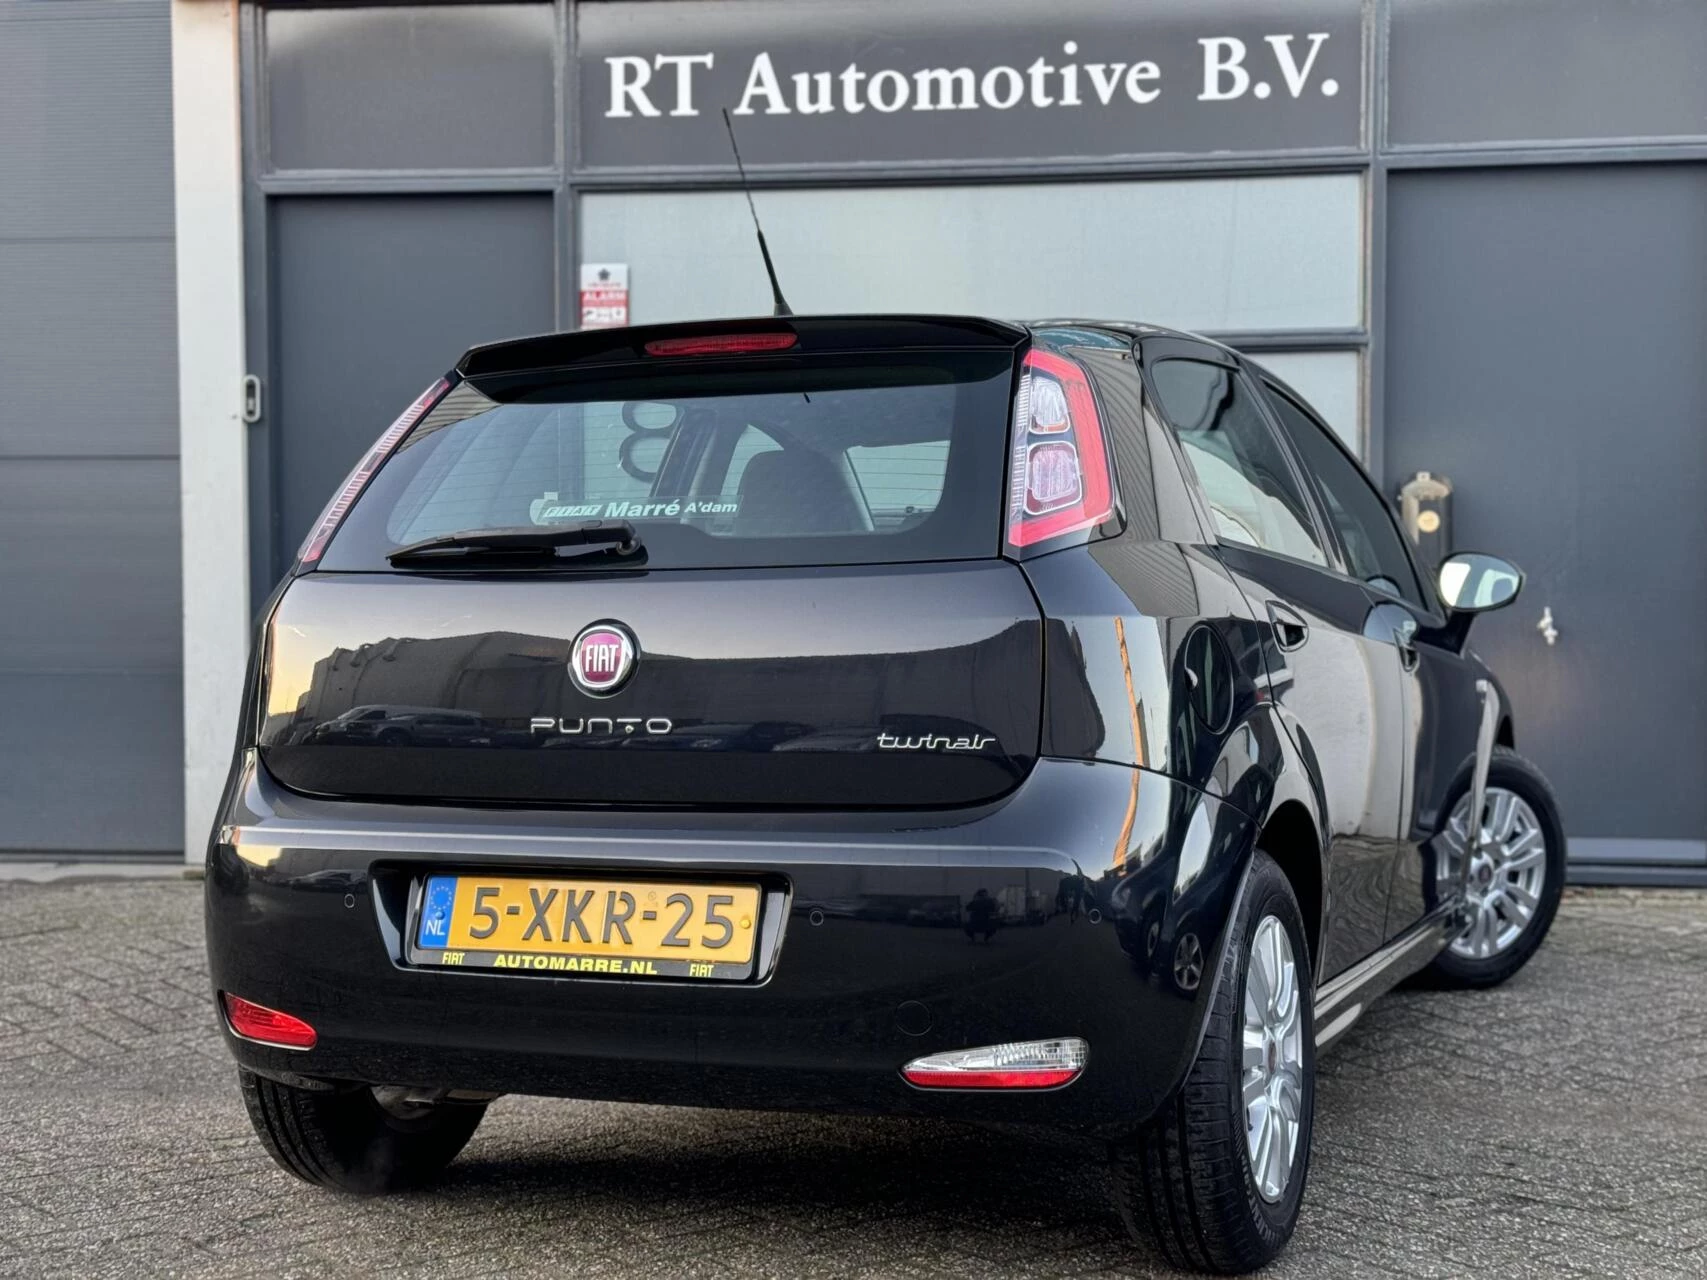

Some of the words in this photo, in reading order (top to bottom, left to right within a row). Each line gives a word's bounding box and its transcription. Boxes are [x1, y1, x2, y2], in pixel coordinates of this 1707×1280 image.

[604, 53, 714, 118] RT
[733, 41, 1162, 115] Automotive
[1197, 33, 1341, 102] B.V.
[604, 499, 681, 518] Marré
[684, 501, 738, 514] A'dam
[584, 643, 619, 673] FIAT
[530, 717, 673, 736] PUNTO
[877, 731, 996, 751] twinair
[425, 918, 446, 937] NL
[469, 886, 735, 949] 5-XKR-25
[442, 952, 465, 966] FIAT
[493, 953, 658, 976] AUTOMARRE.NL
[689, 963, 714, 978] FIAT
